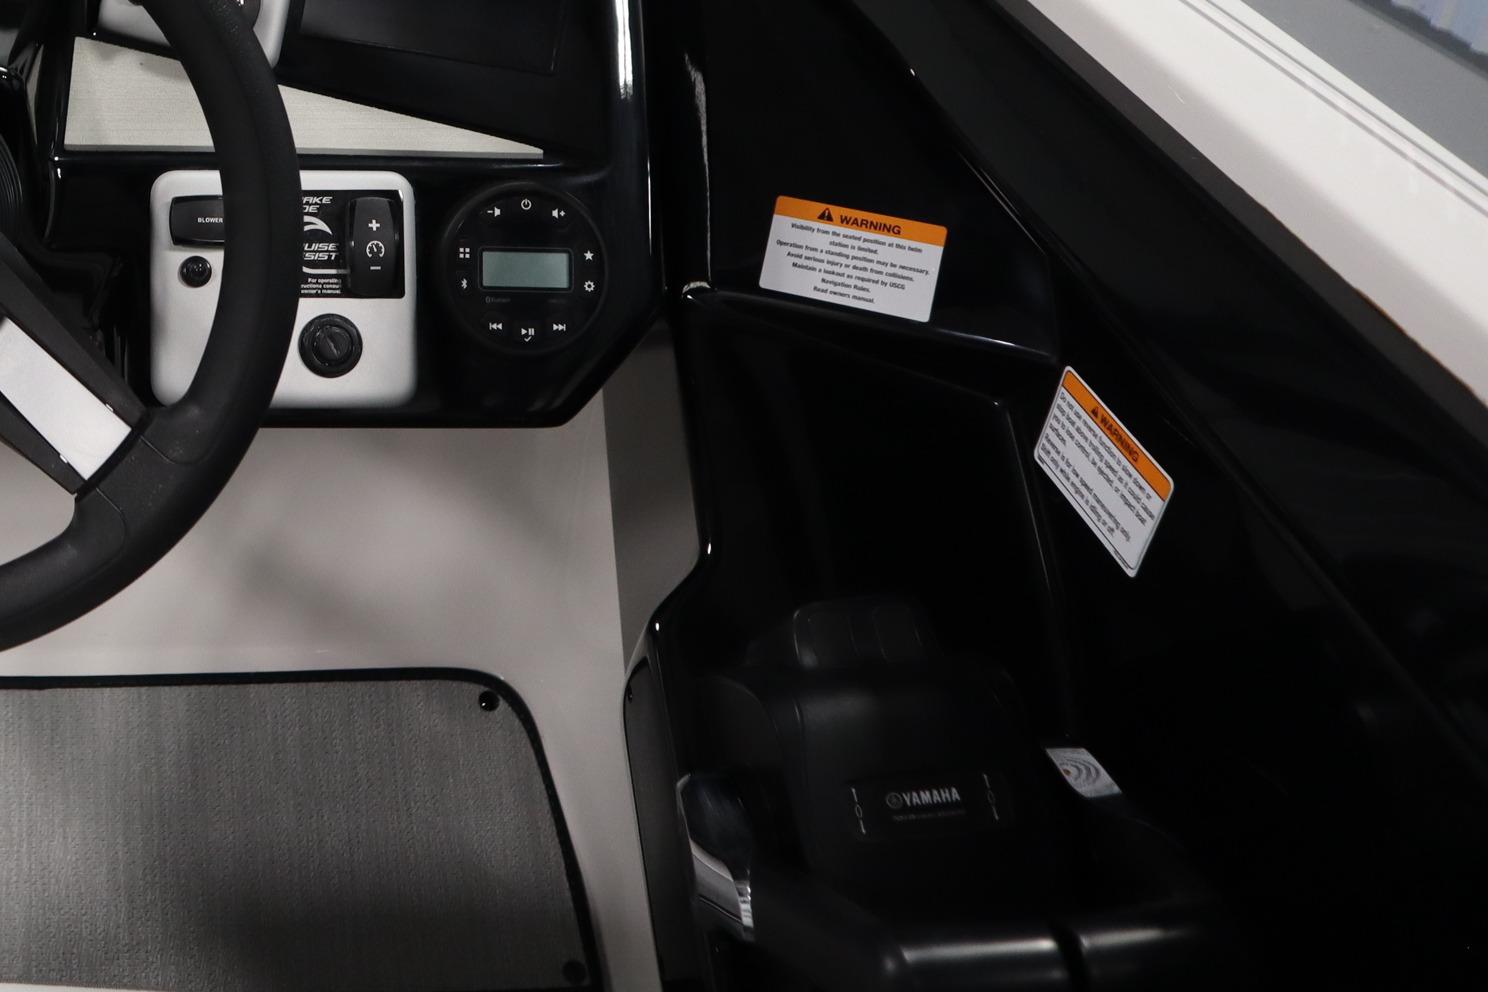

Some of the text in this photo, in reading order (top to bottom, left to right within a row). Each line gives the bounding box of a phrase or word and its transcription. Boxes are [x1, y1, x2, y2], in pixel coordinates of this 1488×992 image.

[303, 196, 333, 204] AKE
[840, 214, 902, 236] WARNING
[304, 242, 338, 251] UISE
[304, 252, 338, 261] SIST
[1100, 414, 1140, 463] WARNING
[902, 786, 960, 807] YAMAHA
